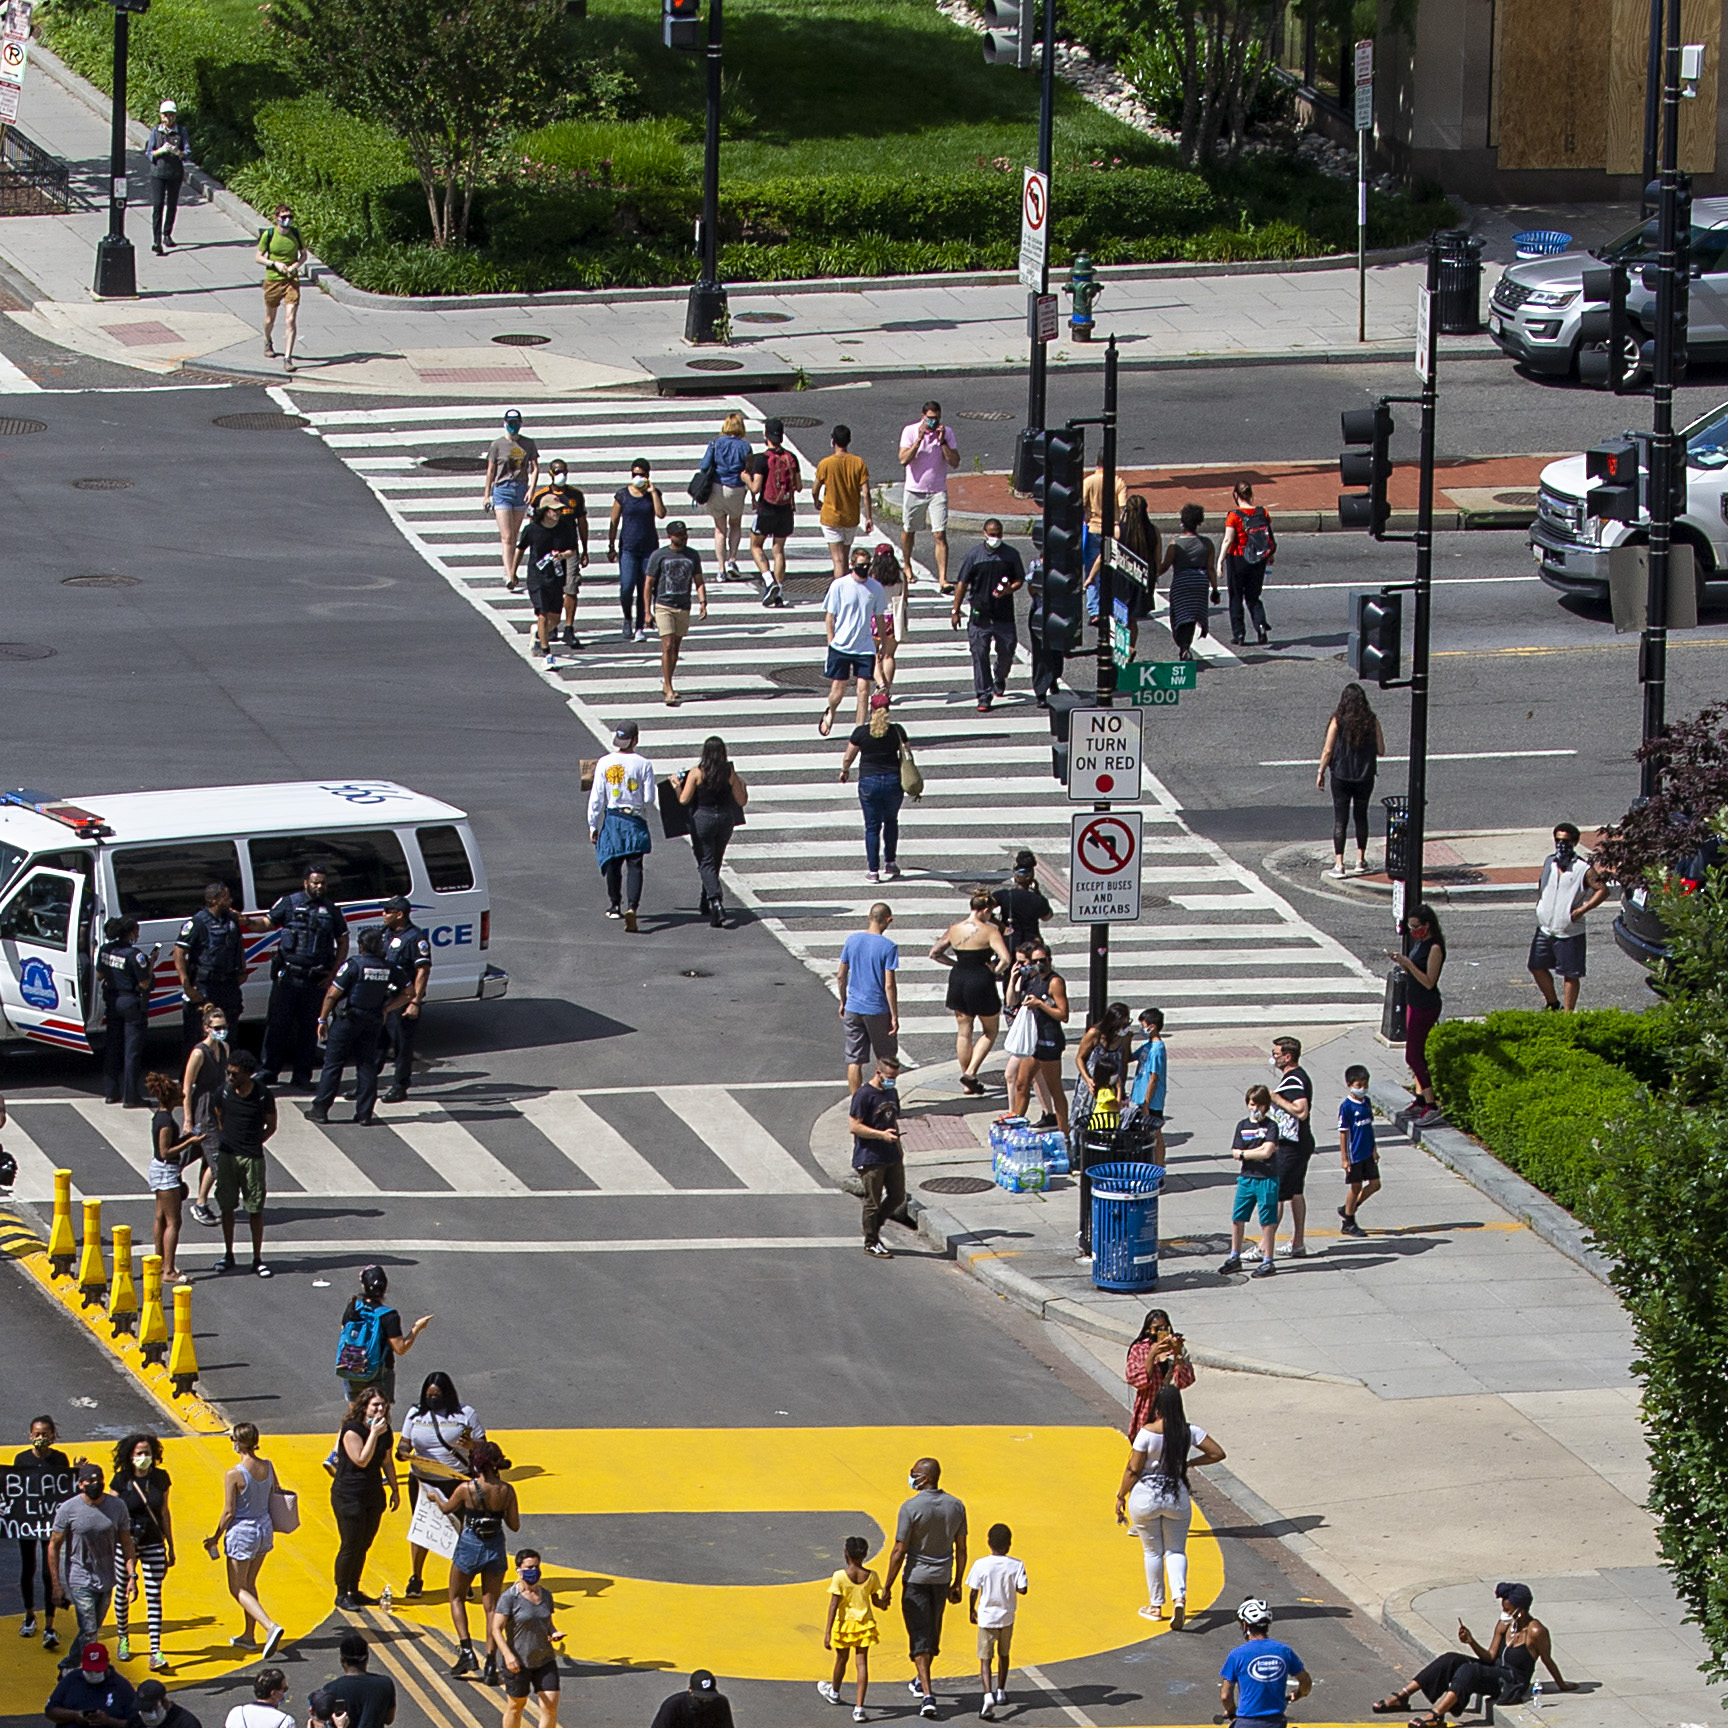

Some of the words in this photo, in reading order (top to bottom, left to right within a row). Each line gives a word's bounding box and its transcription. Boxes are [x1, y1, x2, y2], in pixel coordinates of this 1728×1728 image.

[1139, 666, 1157, 687] K
[1172, 666, 1186, 676] ST
[1170, 675, 1186, 686] NW
[1134, 690, 1177, 705] 1500
[1091, 716, 1122, 733] NO
[1086, 738, 1127, 752] TURN
[1076, 757, 1097, 770] ON
[1105, 756, 1135, 770] RED
[1076, 881, 1104, 892] EXCEPT
[1107, 880, 1132, 891] BUSES
[1093, 893, 1113, 903] AND
[1079, 904, 1130, 915] TAXICABS
[26, 1499, 63, 1515] Liv
[412, 1499, 432, 1535] THIS
